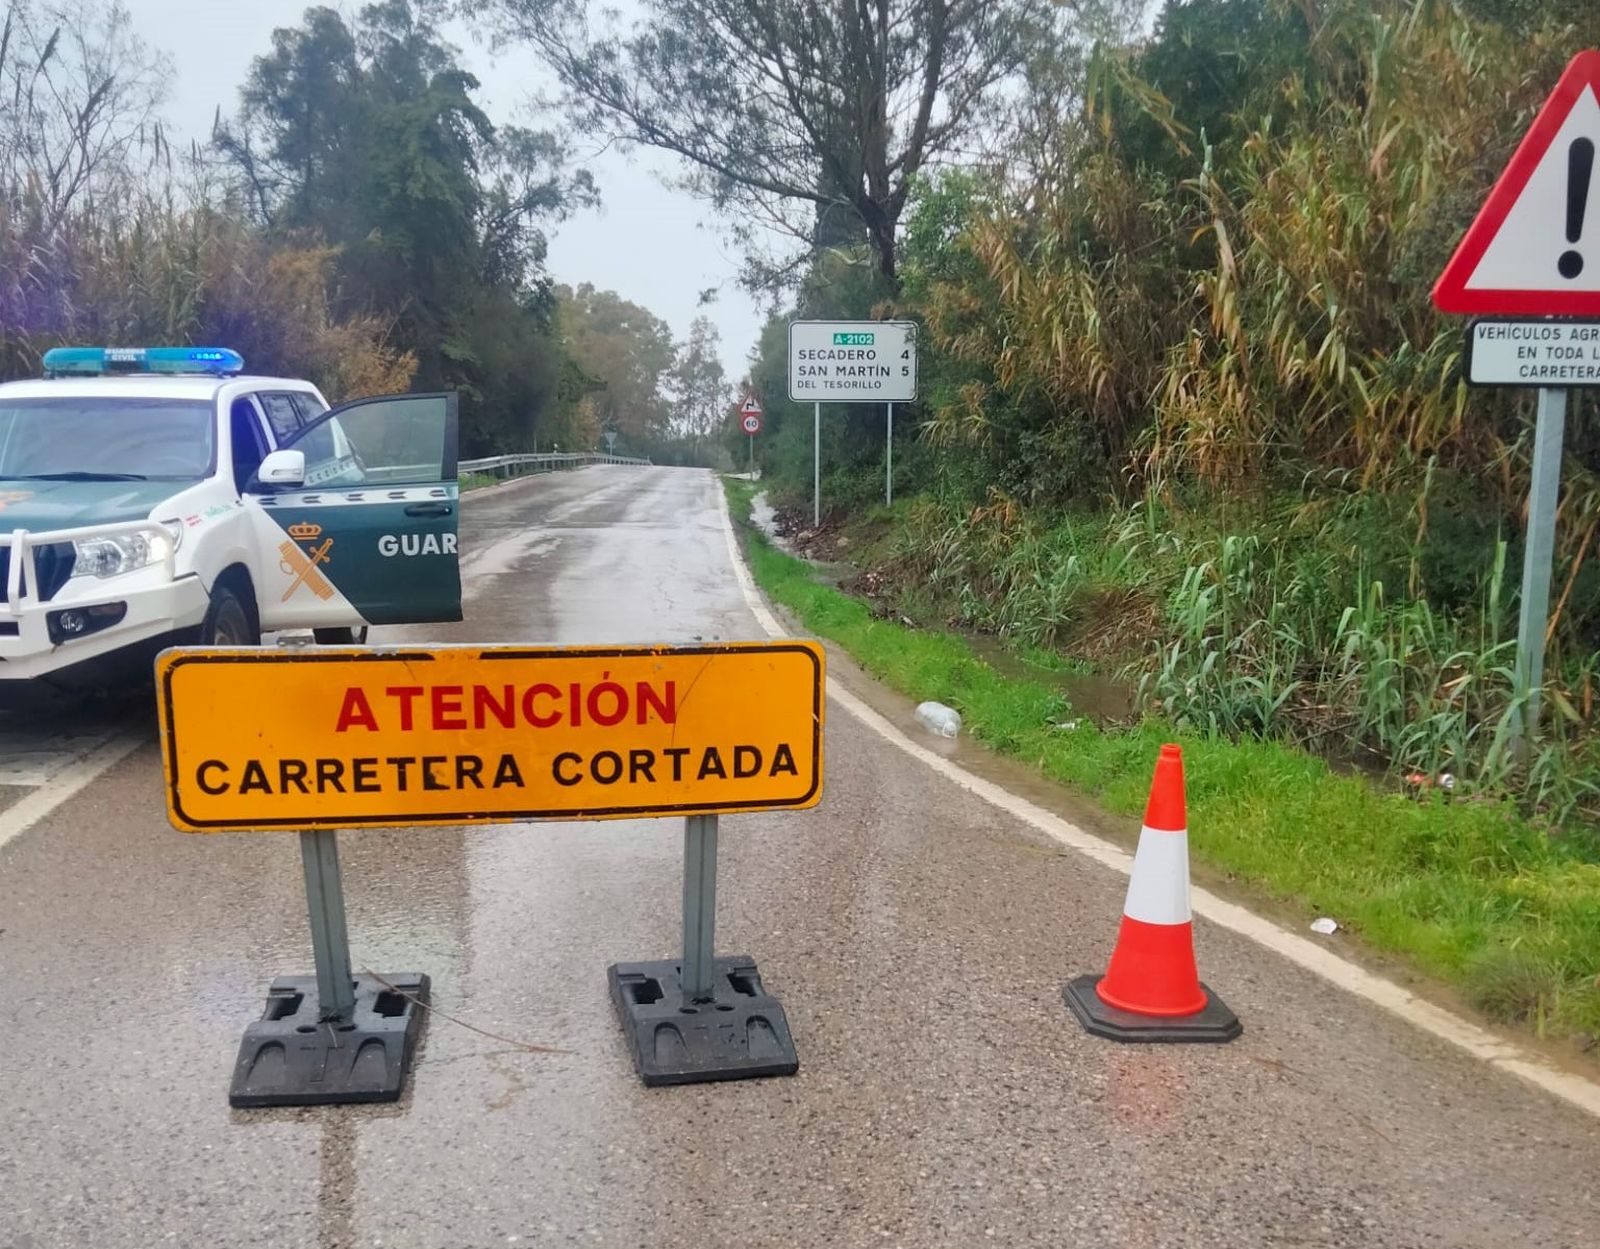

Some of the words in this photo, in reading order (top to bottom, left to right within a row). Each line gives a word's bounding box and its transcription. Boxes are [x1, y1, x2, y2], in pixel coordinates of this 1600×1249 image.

[834, 334, 873, 344] A-2102
[1479, 326, 1561, 340] VEHÍCULOS
[798, 350, 876, 360] SECADERO
[901, 350, 910, 360] 4
[1517, 347, 1537, 359] EN
[1546, 346, 1583, 360] TODA
[798, 366, 828, 376] SAN
[836, 364, 890, 376] MARTÍN
[901, 366, 909, 376] 5
[797, 381, 816, 389] DEL
[823, 381, 882, 389] TESORILLO
[746, 420, 757, 428] 60
[378, 533, 458, 557] GUAR
[335, 671, 678, 732] ATENCIÓN
[195, 754, 525, 795] CARRETERA
[552, 743, 799, 785] CORTADA
